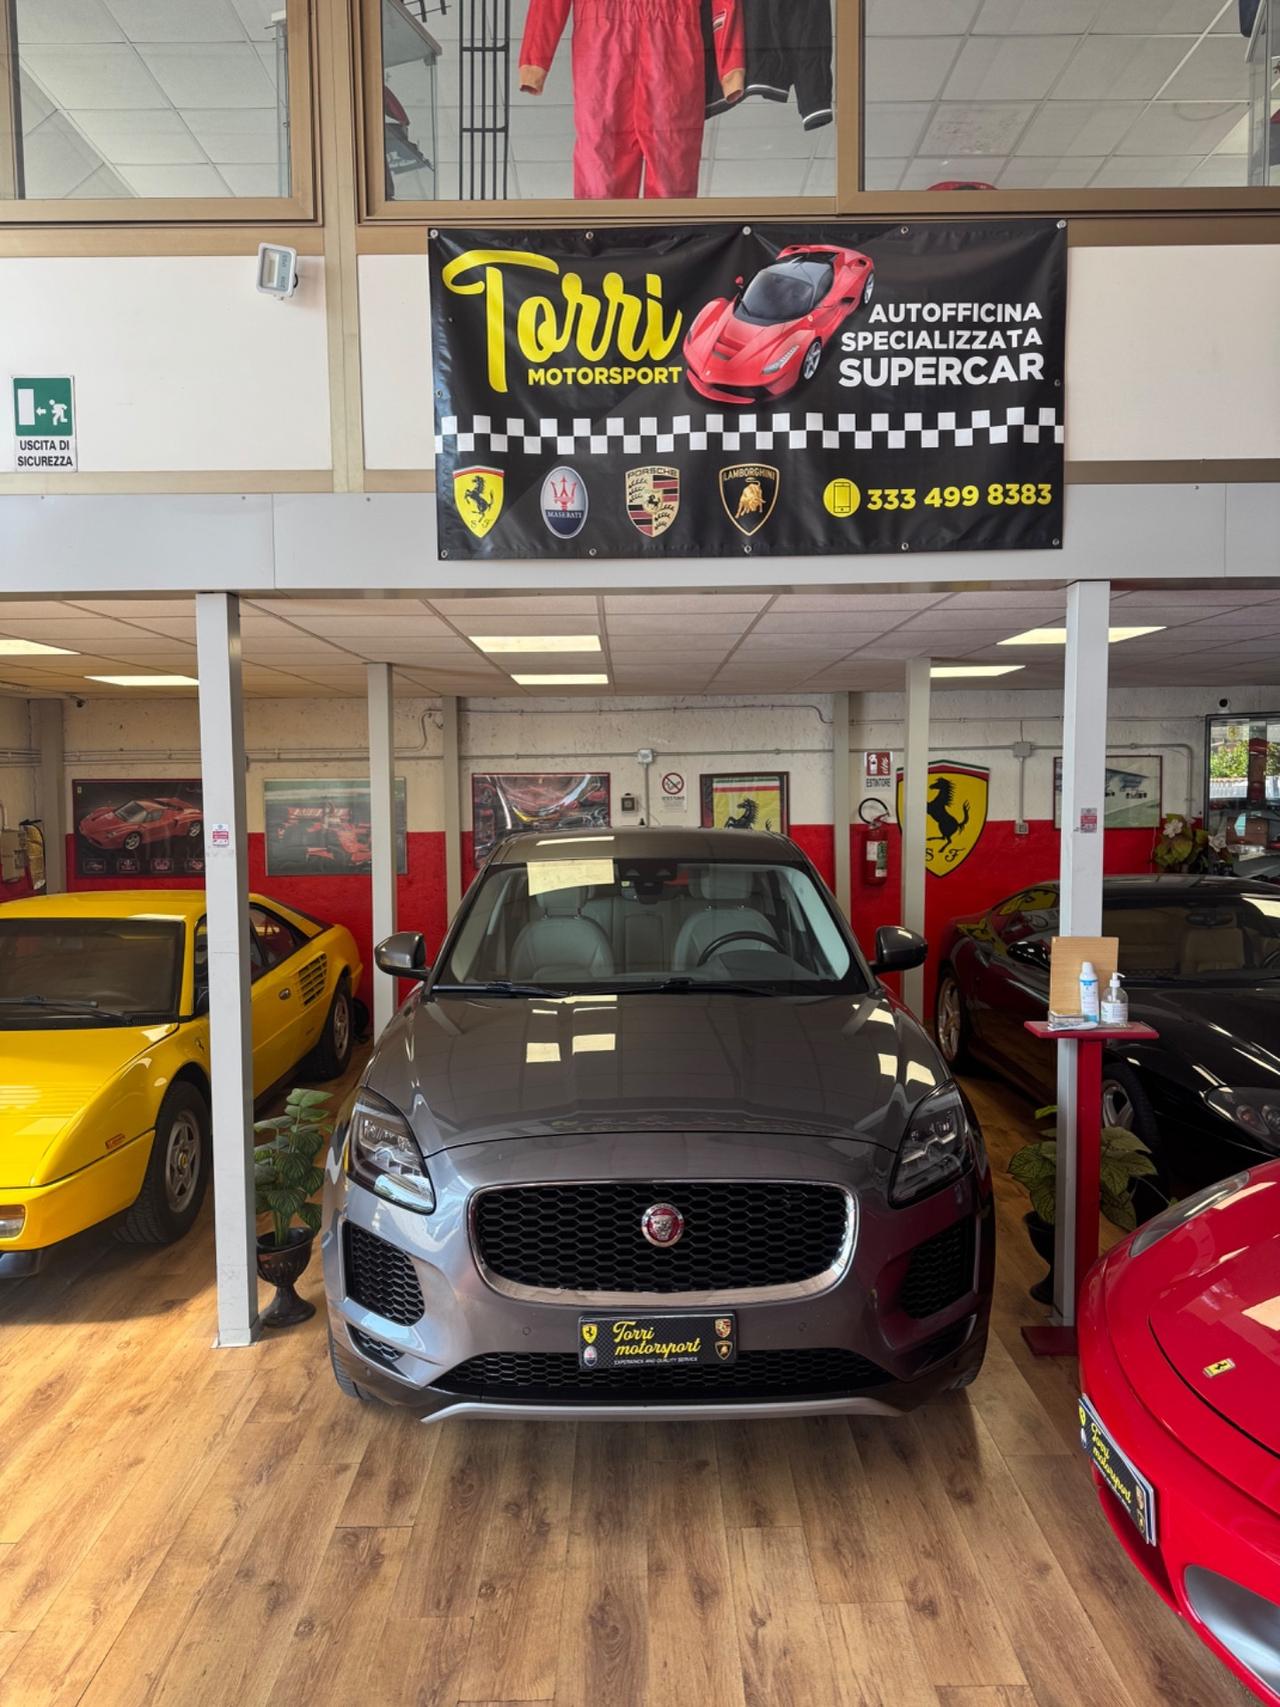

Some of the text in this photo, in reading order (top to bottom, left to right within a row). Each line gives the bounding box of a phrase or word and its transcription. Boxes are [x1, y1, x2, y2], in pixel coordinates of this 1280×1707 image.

[442, 249, 683, 393] Torri
[868, 302, 1043, 324] AUTOFFICINA
[840, 327, 1043, 352] SPECIALIZZATA
[528, 366, 683, 386] MOTORSPORT
[838, 352, 1045, 388] SUPERCAR
[19, 439, 70, 451] USCITA DI
[17, 455, 74, 467] SICUREZZA
[627, 466, 678, 479] PORSCHE
[723, 466, 776, 482] LAMBORGHINI
[867, 483, 1052, 511] 333 499 8383
[547, 510, 582, 519] MASERATI
[612, 1321, 654, 1343] Torri
[614, 1337, 702, 1358] motorsport
